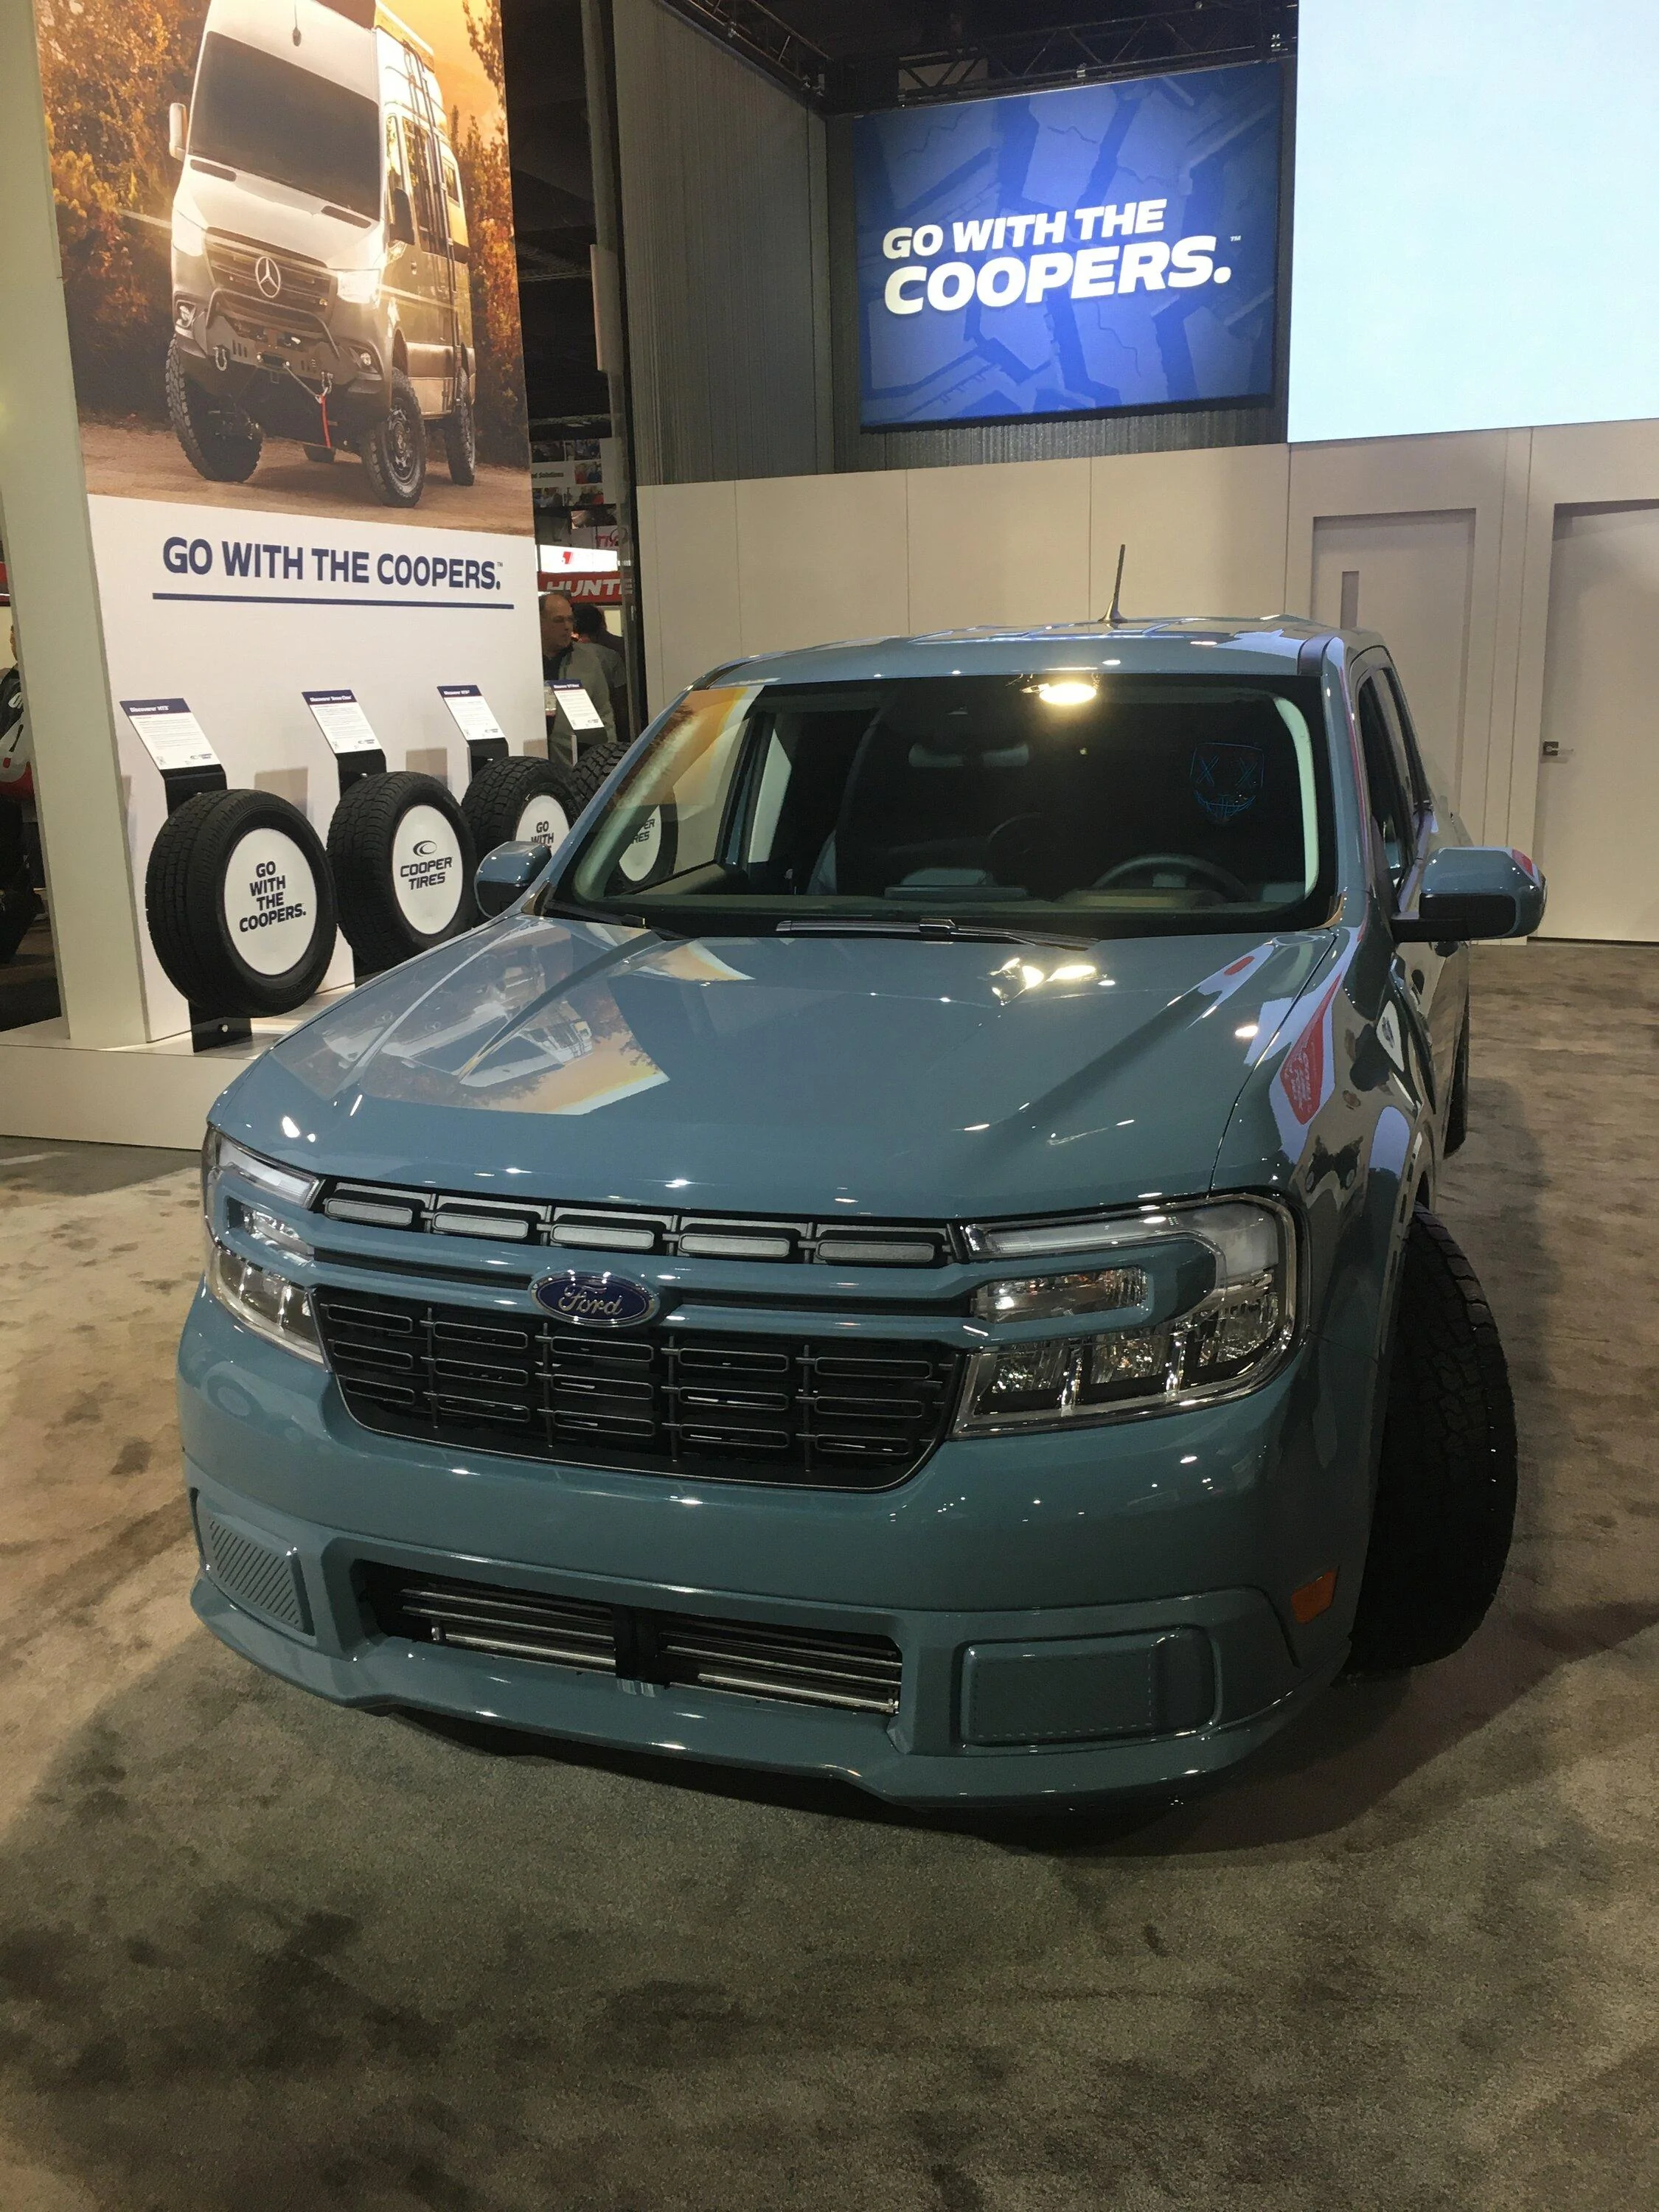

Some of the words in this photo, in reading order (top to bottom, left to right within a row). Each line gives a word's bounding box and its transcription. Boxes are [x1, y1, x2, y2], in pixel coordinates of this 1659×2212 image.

[883, 224, 943, 260] GO
[953, 210, 1067, 254] WITH
[1074, 198, 1167, 240] THE
[162, 536, 213, 575] GO
[221, 540, 304, 580] WITH
[311, 548, 369, 583] THE
[536, 821, 549, 833] GO
[531, 832, 554, 844] WITH
[256, 861, 276, 877] GO
[400, 857, 452, 877] COOPER
[249, 875, 286, 897] WITH
[408, 872, 445, 890] TIRES
[257, 891, 284, 911] THE
[240, 903, 306, 932] COOPERS.
[558, 1284, 623, 1315] Ford
